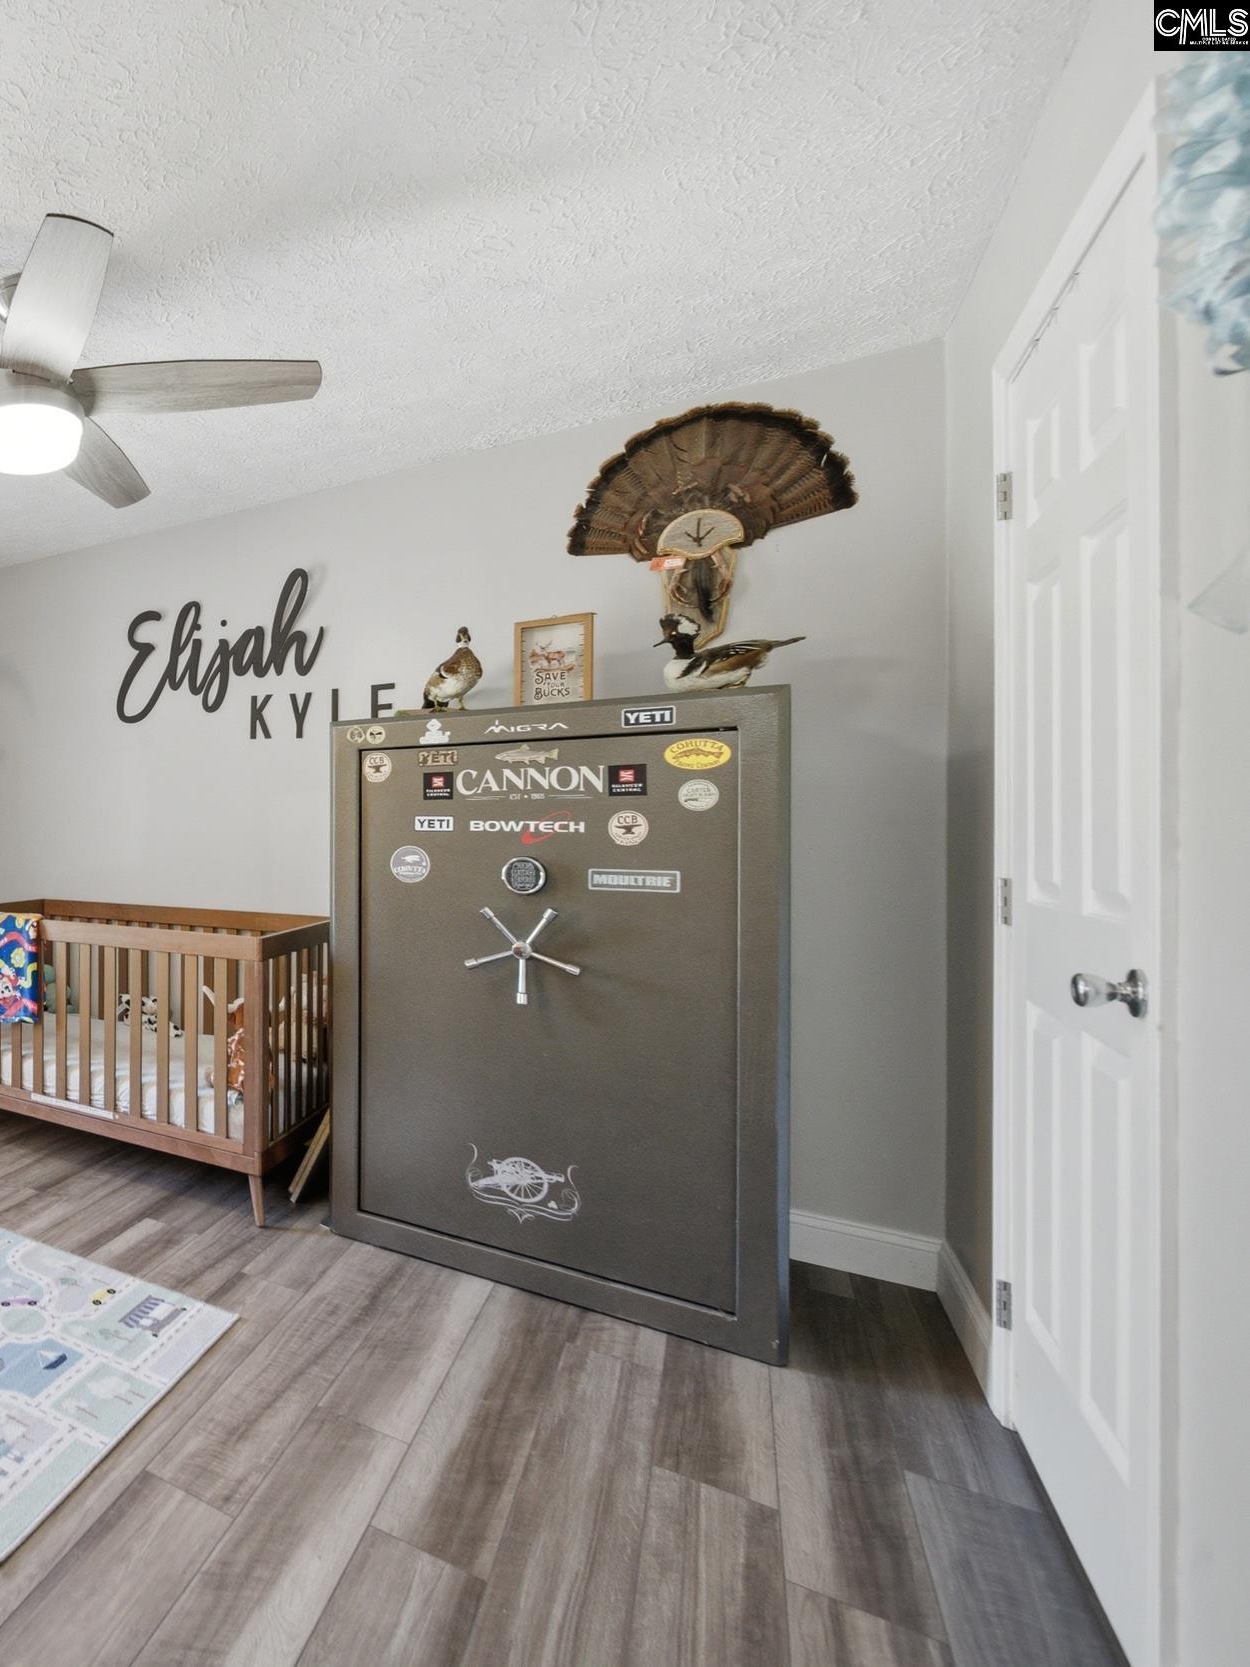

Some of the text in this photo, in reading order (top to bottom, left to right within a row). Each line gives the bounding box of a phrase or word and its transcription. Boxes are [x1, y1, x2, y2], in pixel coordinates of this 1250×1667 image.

[116, 567, 325, 724] Elijah
[533, 687, 571, 700] BUCKS
[625, 710, 672, 724] YETI
[484, 719, 570, 734] MIGRA
[669, 740, 726, 754] COHUTTA
[369, 756, 385, 765] CCB
[419, 750, 457, 765] YETI
[455, 765, 605, 795] CANNON
[417, 819, 450, 829] YETI
[469, 820, 585, 833] BOWTECH
[617, 815, 639, 824] CCB
[592, 873, 675, 888] MOULTRIE
